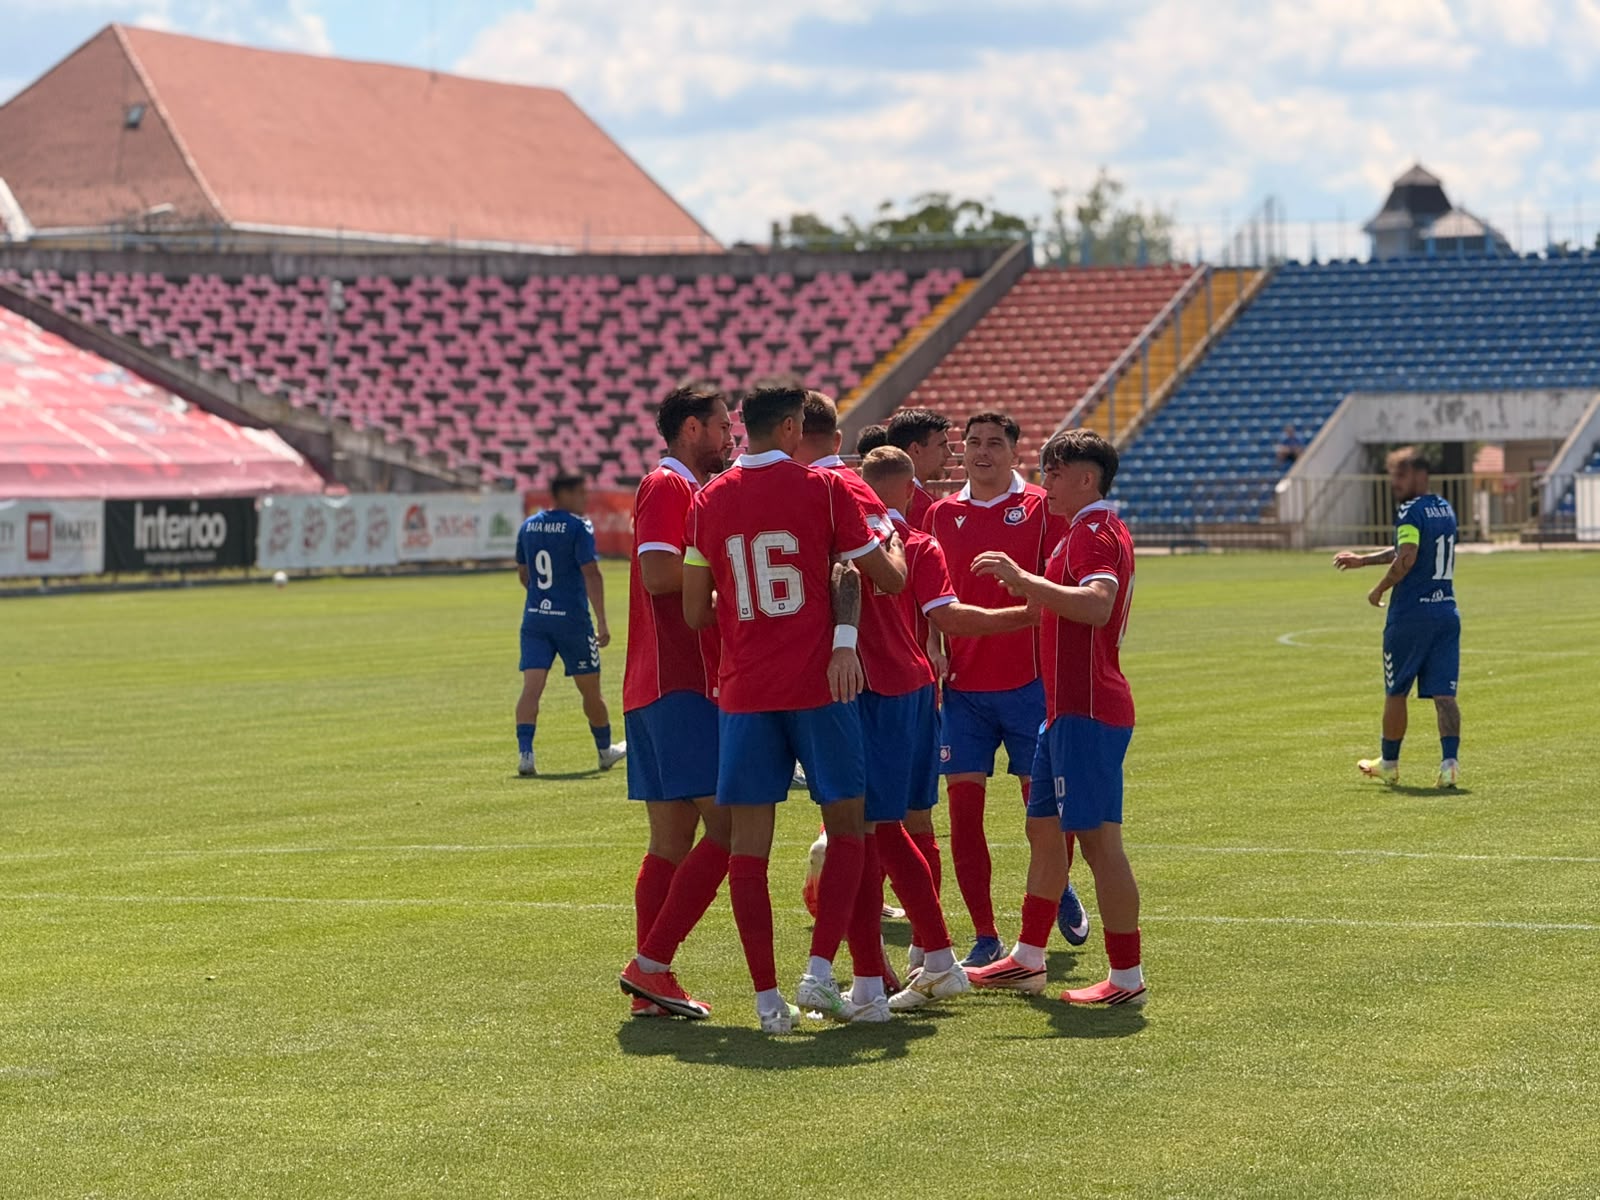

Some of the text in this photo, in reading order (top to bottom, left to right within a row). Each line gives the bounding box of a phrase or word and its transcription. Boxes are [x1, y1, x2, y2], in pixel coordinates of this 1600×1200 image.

[134, 501, 226, 549] Interioo
[544, 522, 567, 533] MARE
[535, 550, 553, 590] 9
[725, 530, 806, 621] 16
[1432, 534, 1455, 580] 11
[1053, 776, 1066, 799] 10
